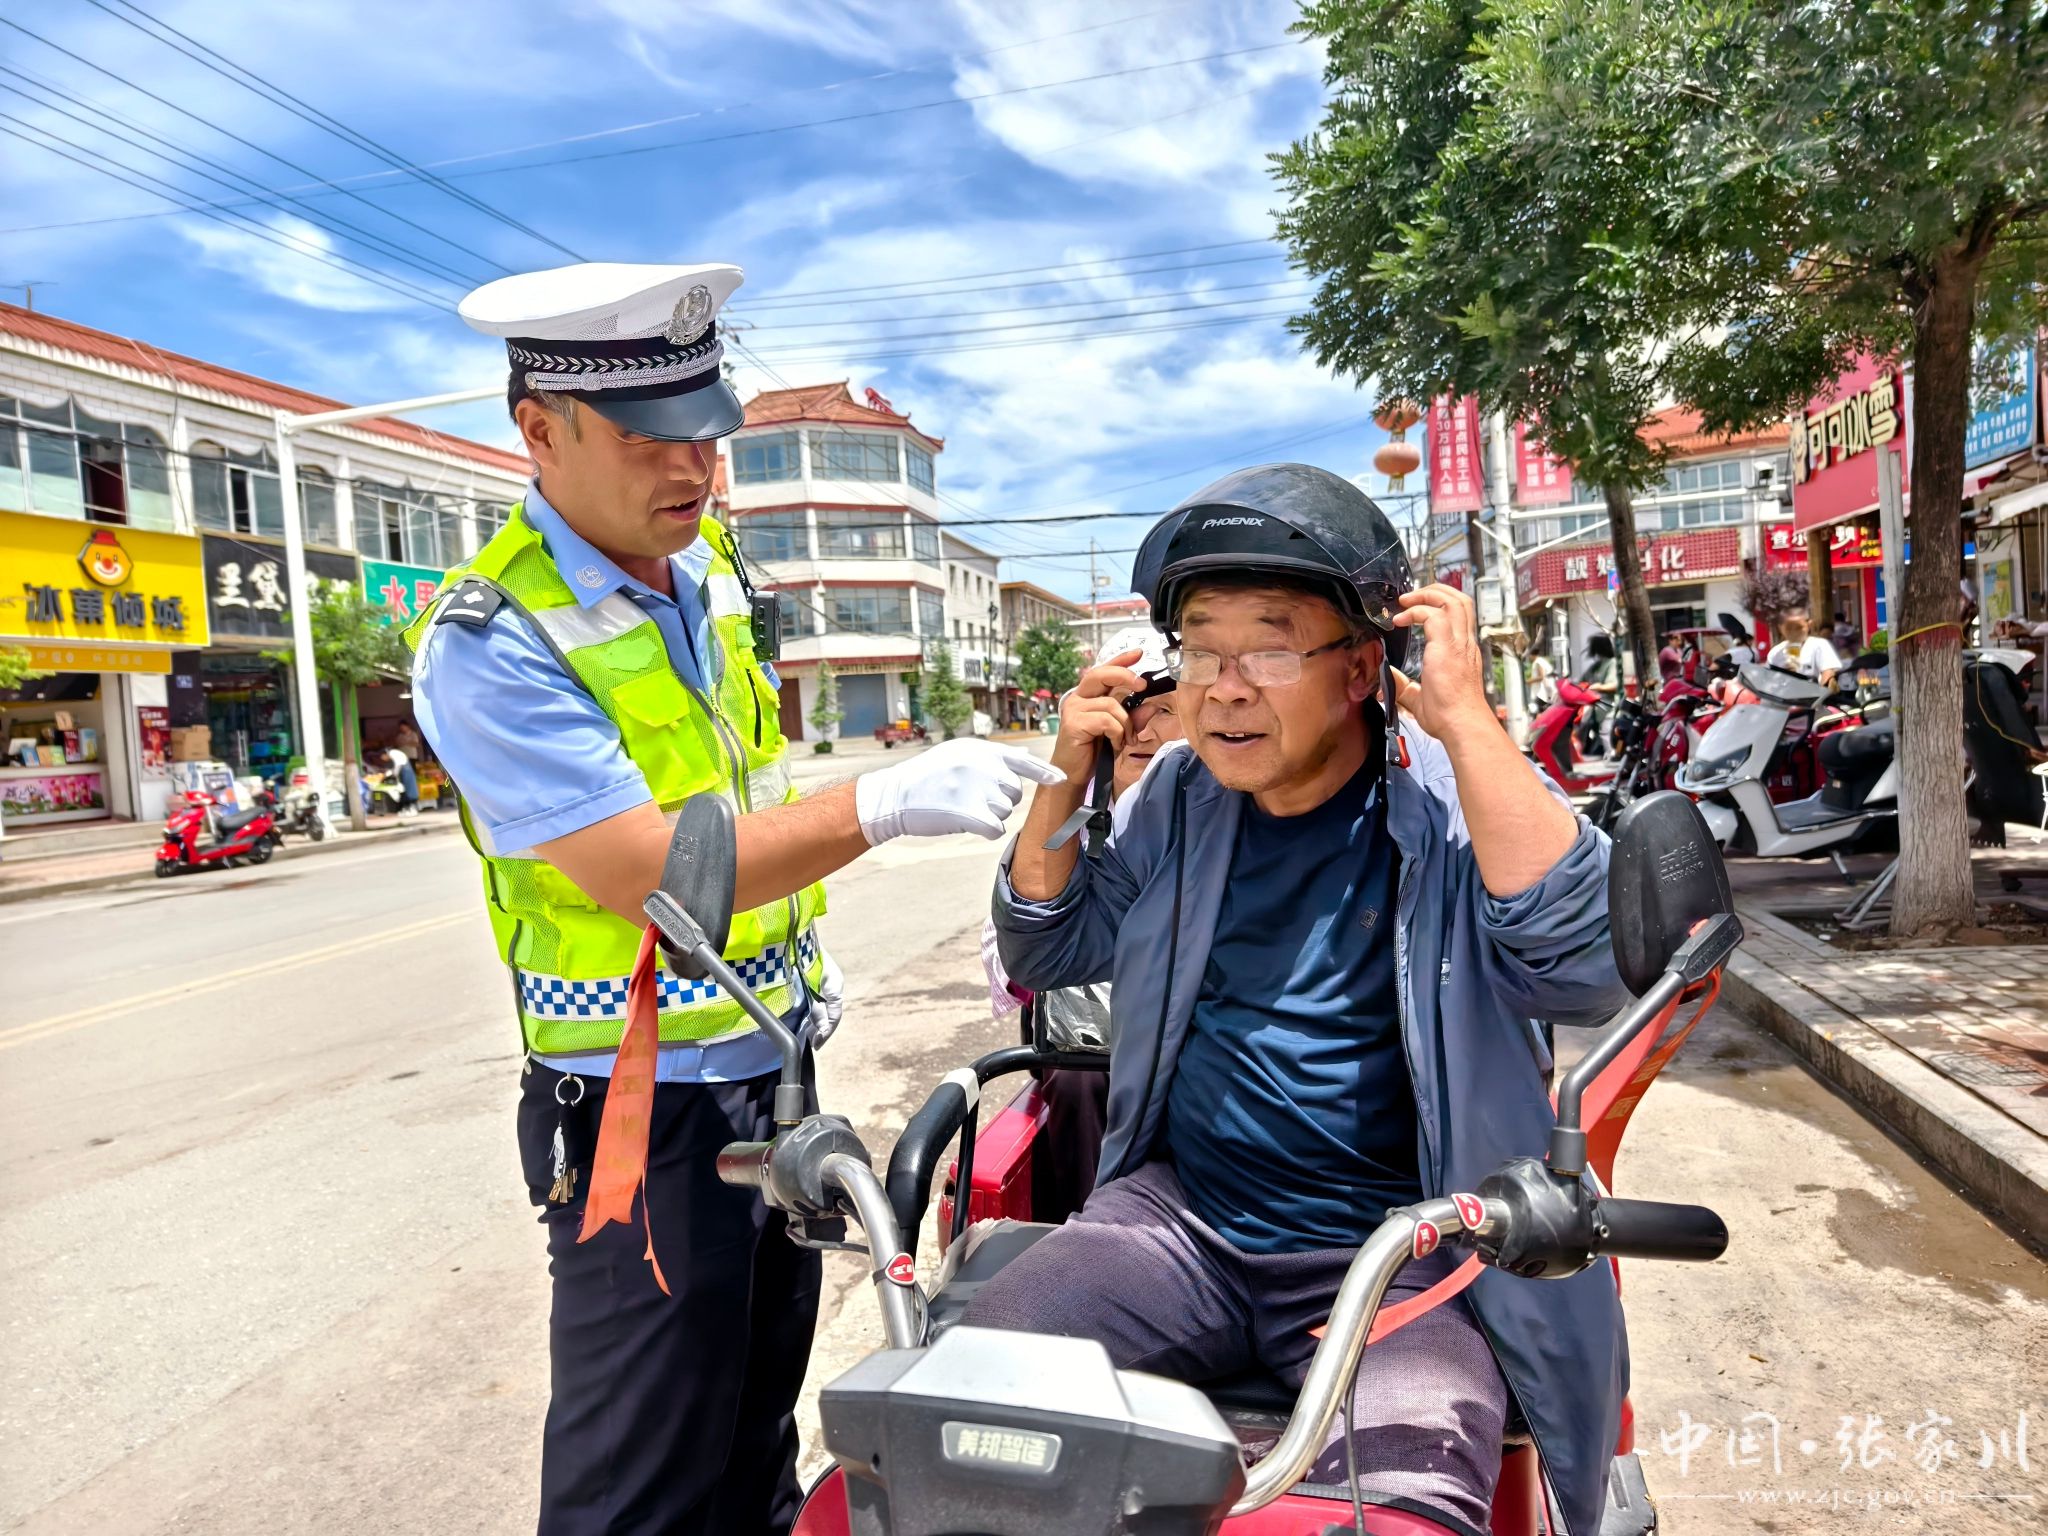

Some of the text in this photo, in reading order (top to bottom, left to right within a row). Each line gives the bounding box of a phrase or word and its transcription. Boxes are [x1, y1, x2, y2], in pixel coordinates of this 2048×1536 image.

[1807, 370, 1898, 471] 可可冰雪
[1202, 517, 1265, 530] PHOENIX
[650, 899, 691, 946] WUYANG
[957, 1428, 1048, 1467] 美邦智造
